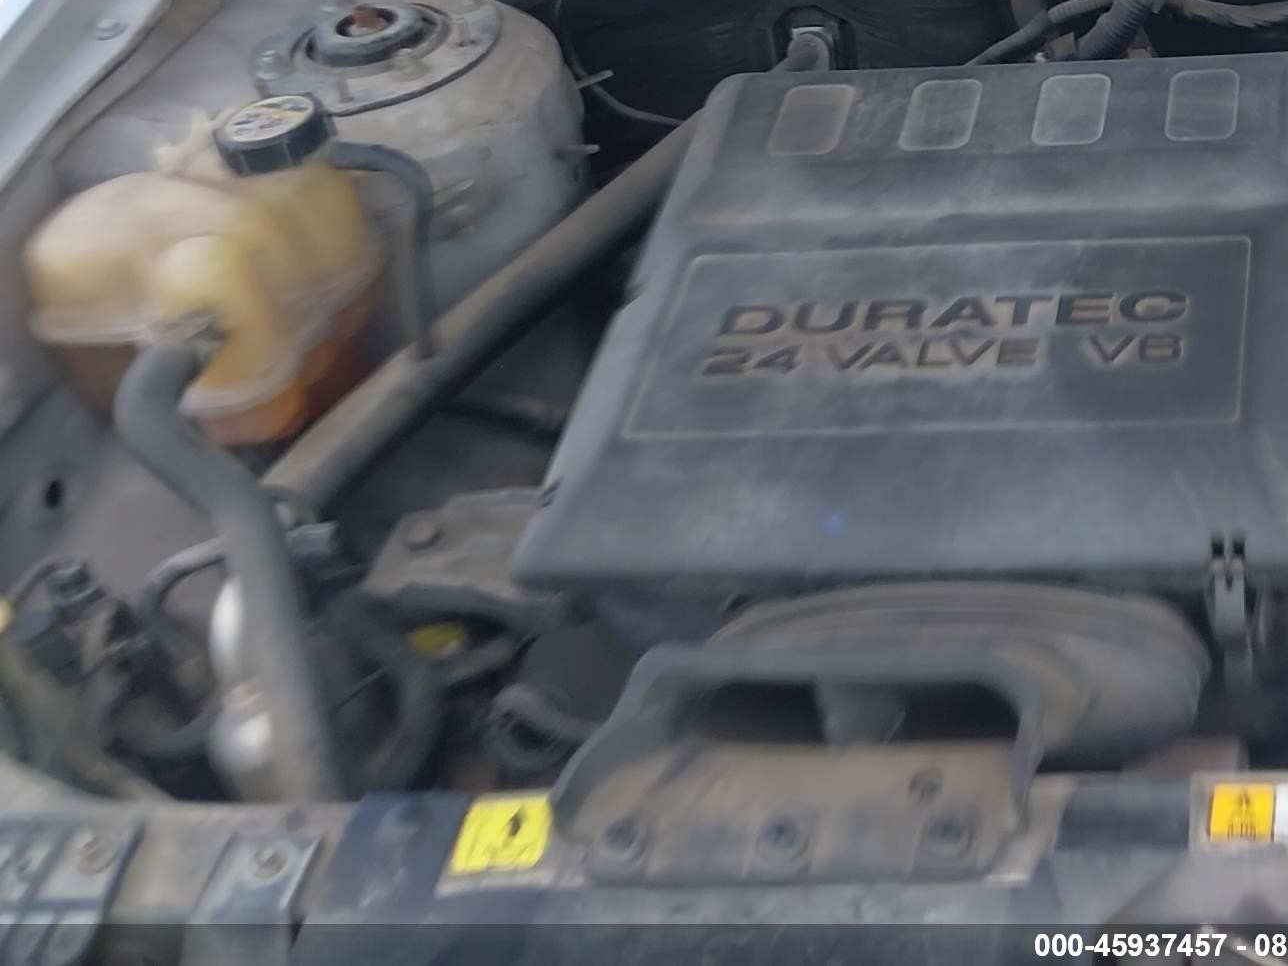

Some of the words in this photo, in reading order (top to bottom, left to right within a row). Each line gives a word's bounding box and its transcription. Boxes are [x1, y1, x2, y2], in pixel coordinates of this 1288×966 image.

[716, 290, 1187, 336] DURATEC
[702, 344, 800, 376] 24
[827, 335, 1041, 372] VALVE
